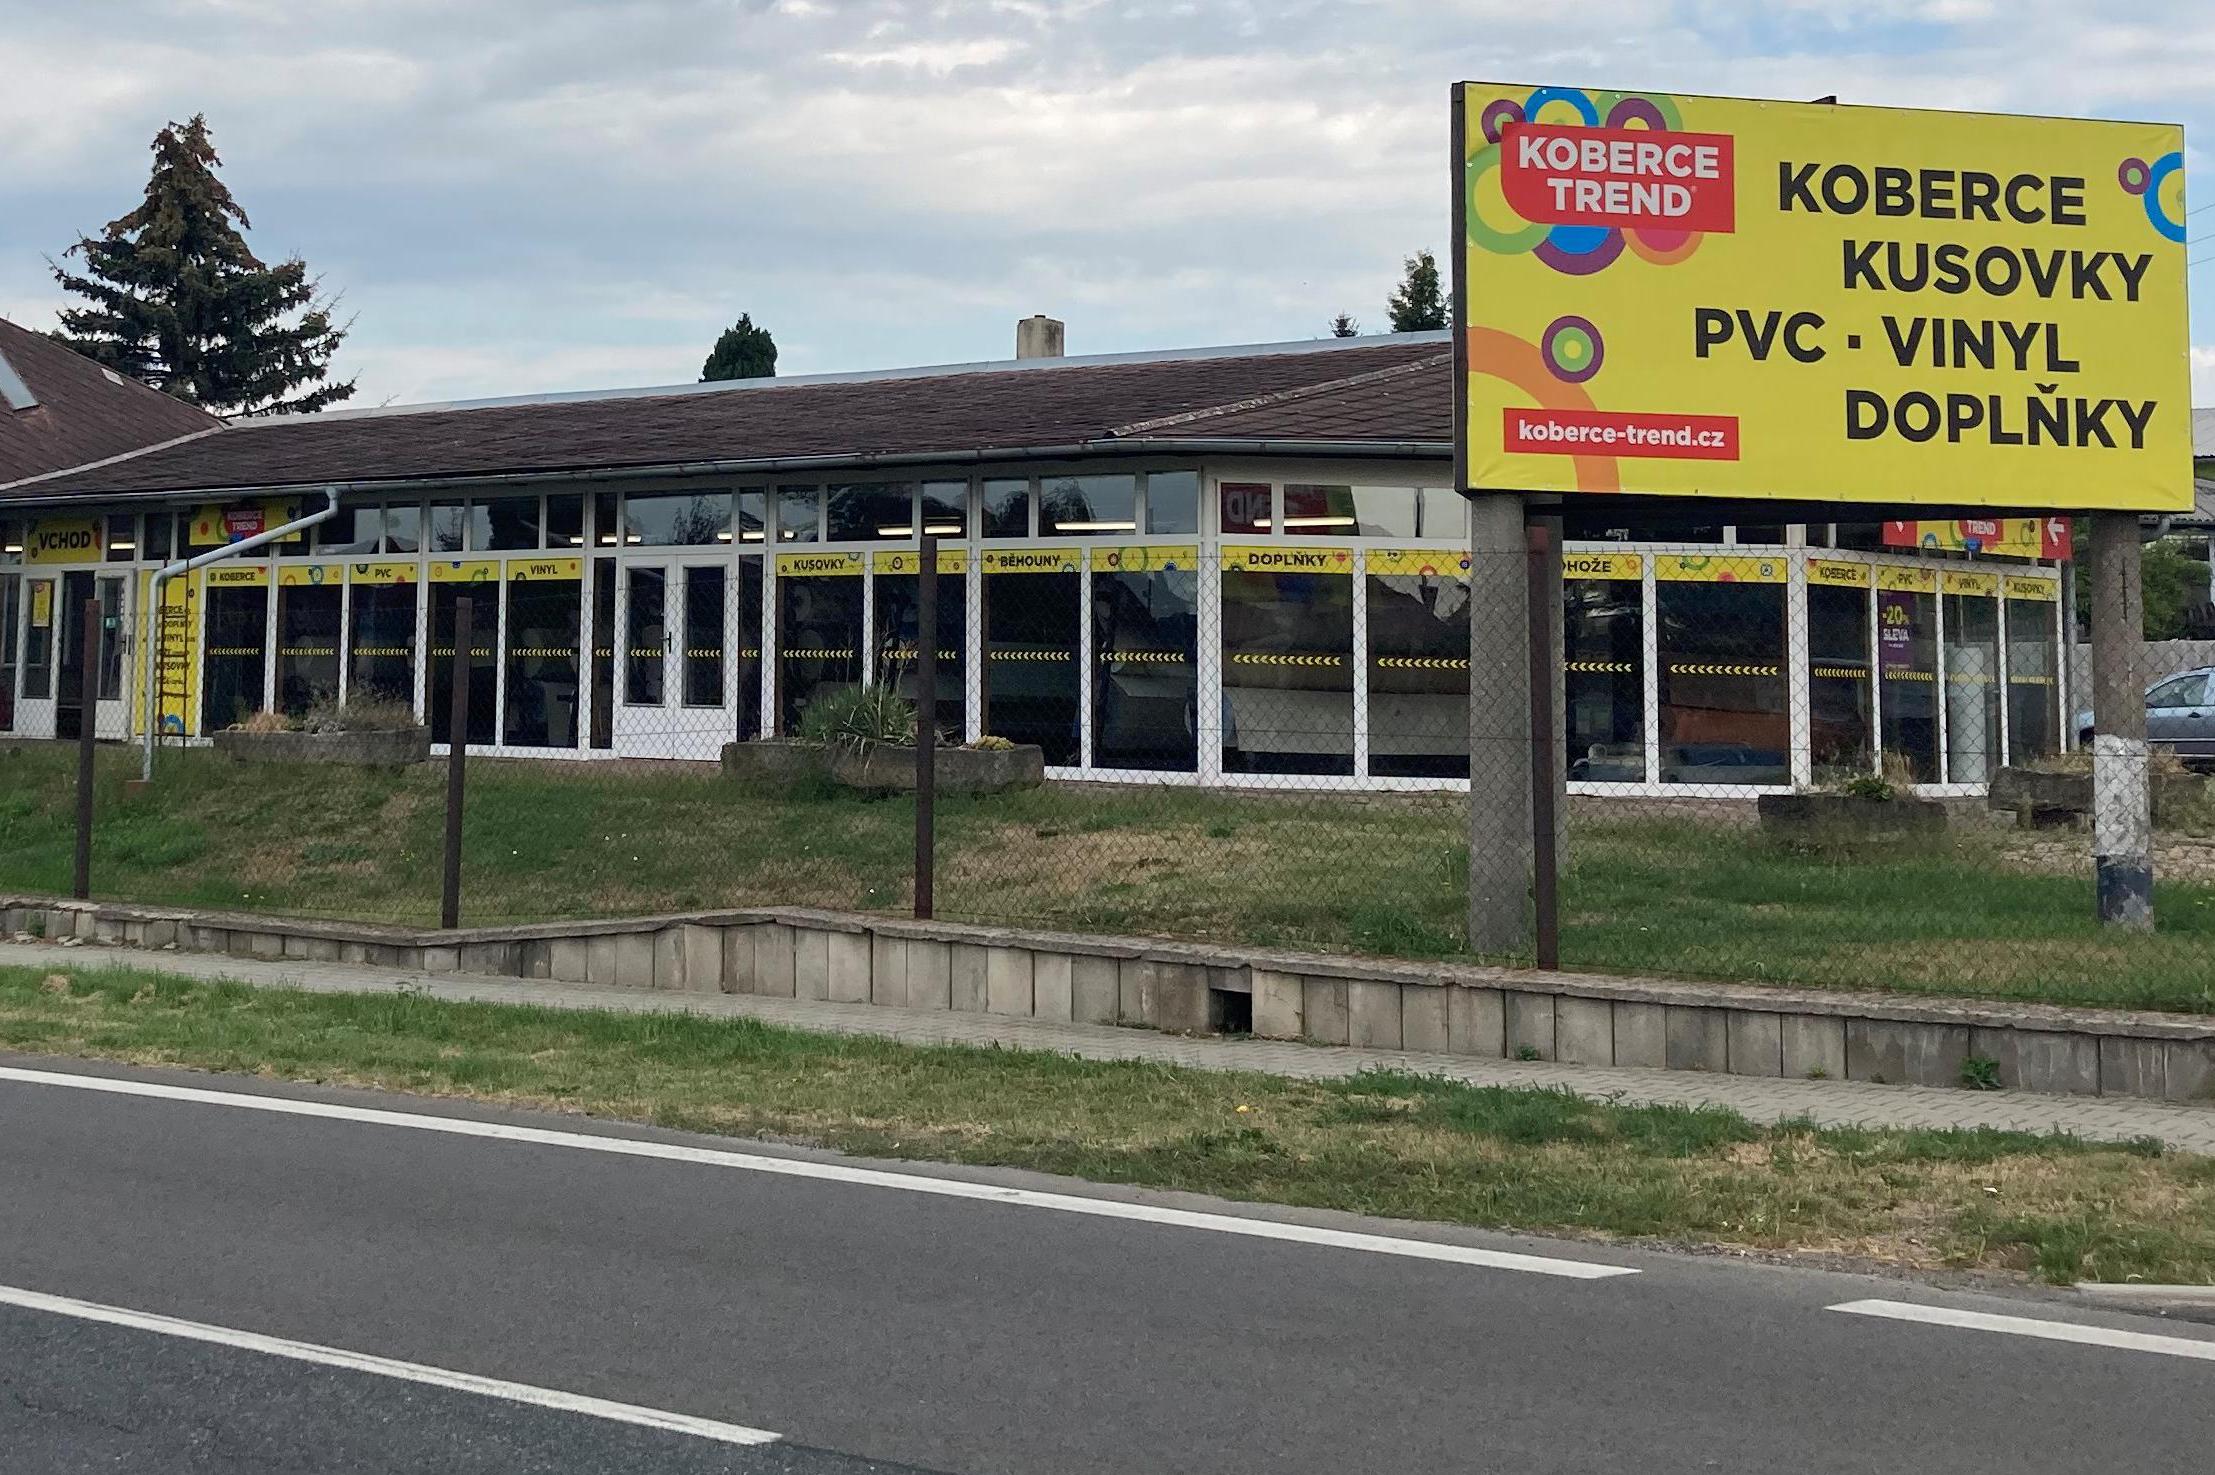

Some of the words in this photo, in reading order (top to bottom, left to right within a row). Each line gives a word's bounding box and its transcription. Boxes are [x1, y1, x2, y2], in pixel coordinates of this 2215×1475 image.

[1519, 136, 1720, 179] KOBERCE
[1547, 178, 1693, 217] TREND
[1779, 161, 2087, 225] KOBERCE
[1843, 240, 2154, 302] KUSOVKY
[1695, 308, 1827, 363] PVC
[1881, 316, 2081, 373] VINYL
[1845, 383, 2157, 450] DOPLŇKY
[1519, 419, 1725, 448] koberce-trend.cz
[233, 521, 257, 531] TREND
[1966, 520, 1996, 536] TREND
[39, 531, 91, 550] VCHOD
[793, 558, 845, 571] KUSOVKY
[1000, 553, 1061, 567] BĚHOUNY
[1248, 551, 1327, 567] DOPLŇKY
[218, 572, 256, 582] KOBERCE
[374, 568, 392, 578] PVC
[530, 564, 558, 575] VINYL
[1883, 628, 1910, 641] SLEVA
